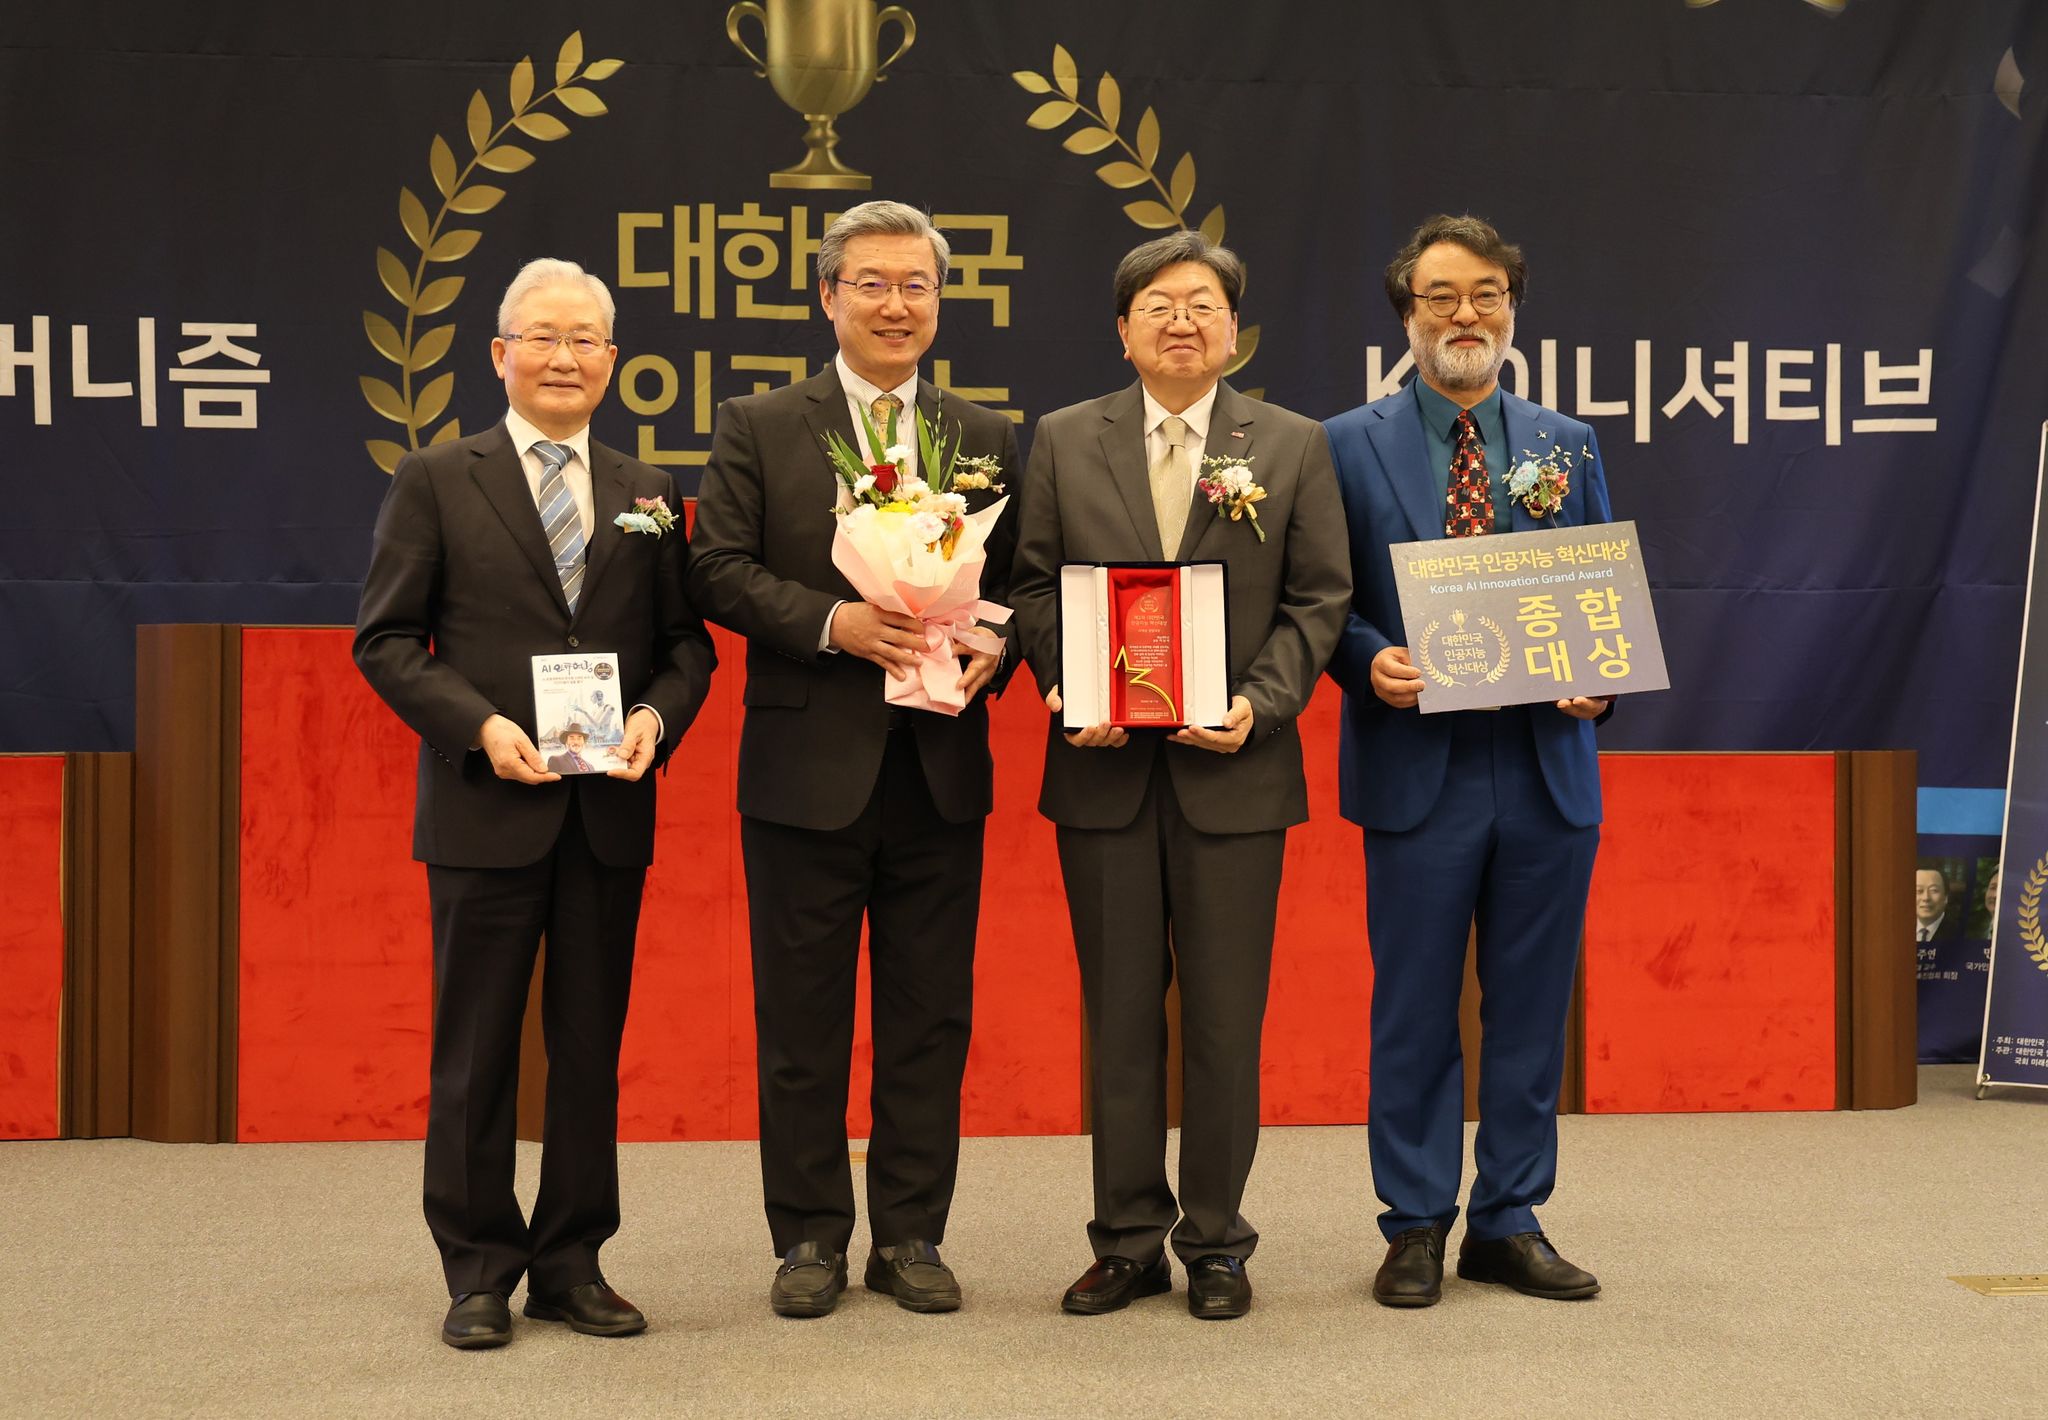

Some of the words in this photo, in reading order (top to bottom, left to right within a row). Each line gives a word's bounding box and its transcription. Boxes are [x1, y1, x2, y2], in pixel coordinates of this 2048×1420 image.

[618, 203, 1024, 328] 대한국
[1408, 554, 1480, 579] 대한민국
[1482, 548, 1554, 573] 인공지능
[1556, 540, 1629, 566] 혁신대상
[1430, 582, 1463, 595] Korea
[1466, 580, 1477, 592] AI
[1479, 575, 1539, 591] Innovation
[1541, 571, 1575, 585] Grand
[1578, 567, 1613, 581] Award
[1441, 632, 1484, 647] 대한민국
[1444, 647, 1486, 662] 인공지능
[1446, 660, 1489, 675] 혁신대상
